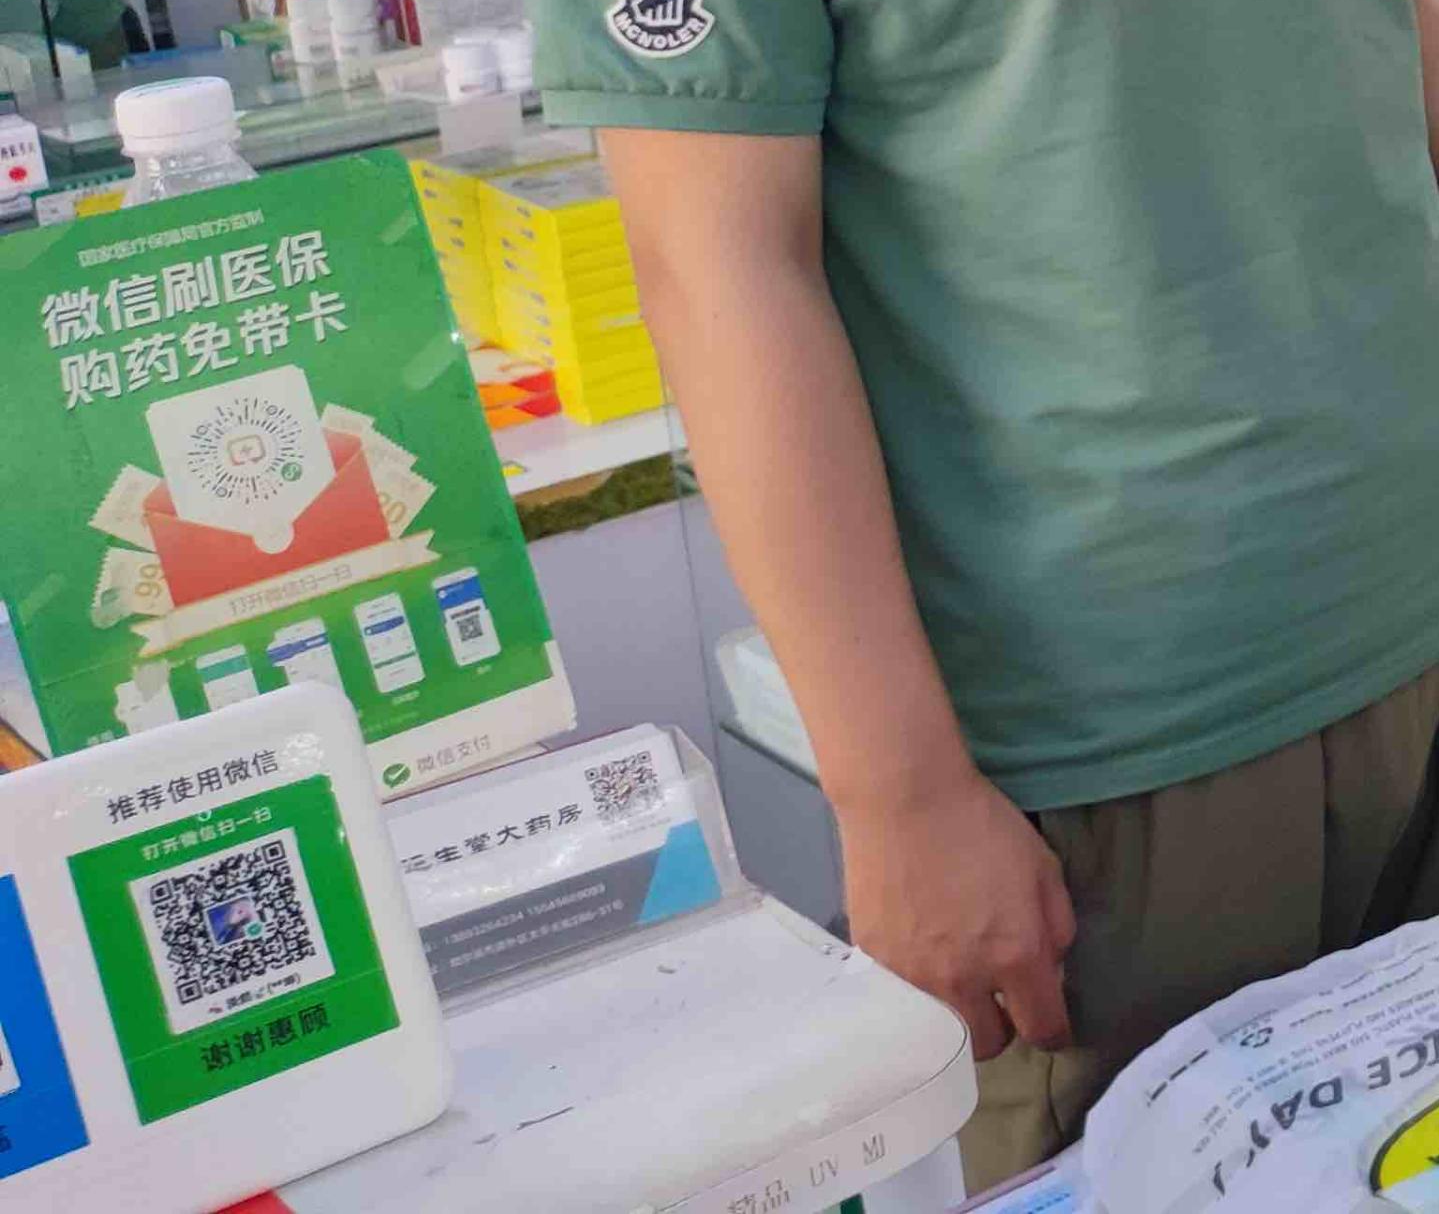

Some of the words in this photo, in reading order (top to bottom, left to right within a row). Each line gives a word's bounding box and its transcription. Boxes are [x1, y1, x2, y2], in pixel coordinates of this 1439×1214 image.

[41, 231, 333, 349] 微信刷医保
[59, 290, 350, 411] 购药免带卡
[229, 562, 352, 617] 打开微信扫一扫
[106, 747, 280, 825] 推荐使用微信
[416, 733, 493, 774] 微信支付
[140, 805, 274, 862] 打开微信扫一扫
[201, 1003, 333, 1072] 谢谢惠顾
